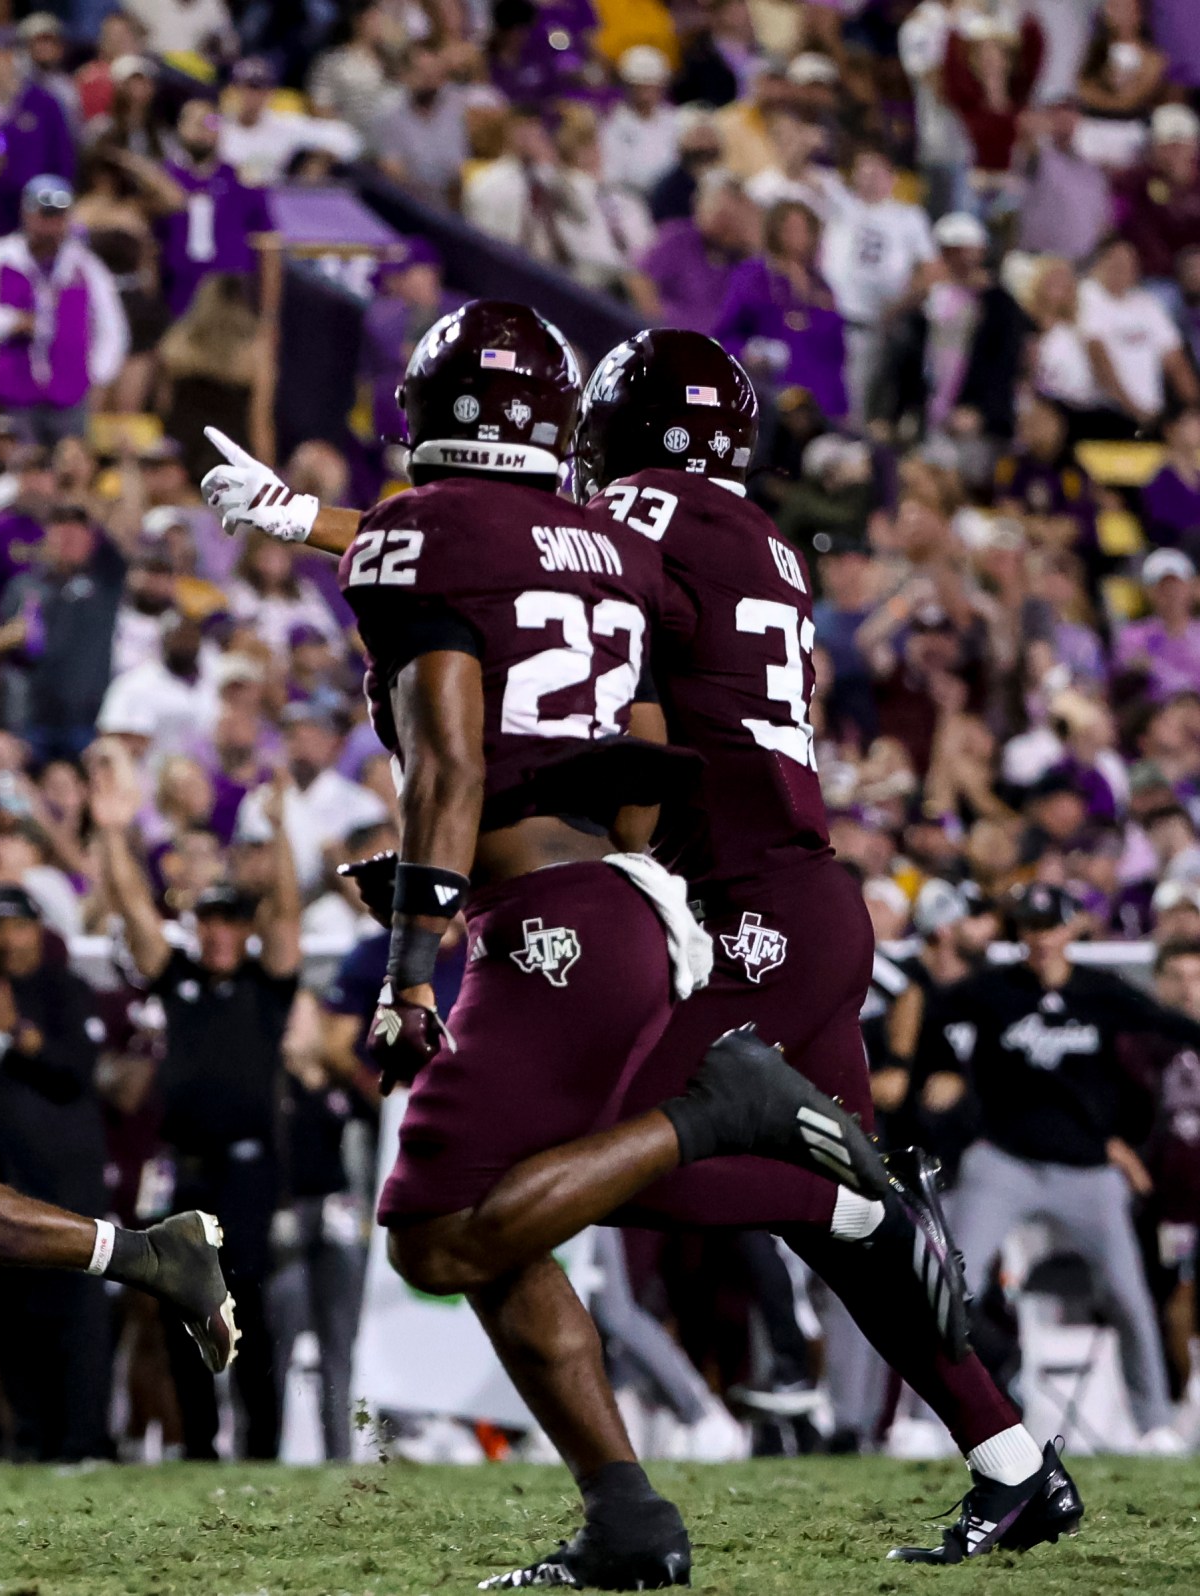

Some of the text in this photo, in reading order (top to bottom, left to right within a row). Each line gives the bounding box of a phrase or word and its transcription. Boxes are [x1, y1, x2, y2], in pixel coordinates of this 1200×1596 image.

[478, 425, 499, 441] 22
[667, 429, 687, 450] SEC
[439, 448, 490, 465] TEXAS
[685, 458, 707, 473] 33
[349, 529, 424, 586] 22
[531, 525, 603, 574] SMITH
[501, 590, 646, 740] 22
[735, 597, 818, 772] 3
